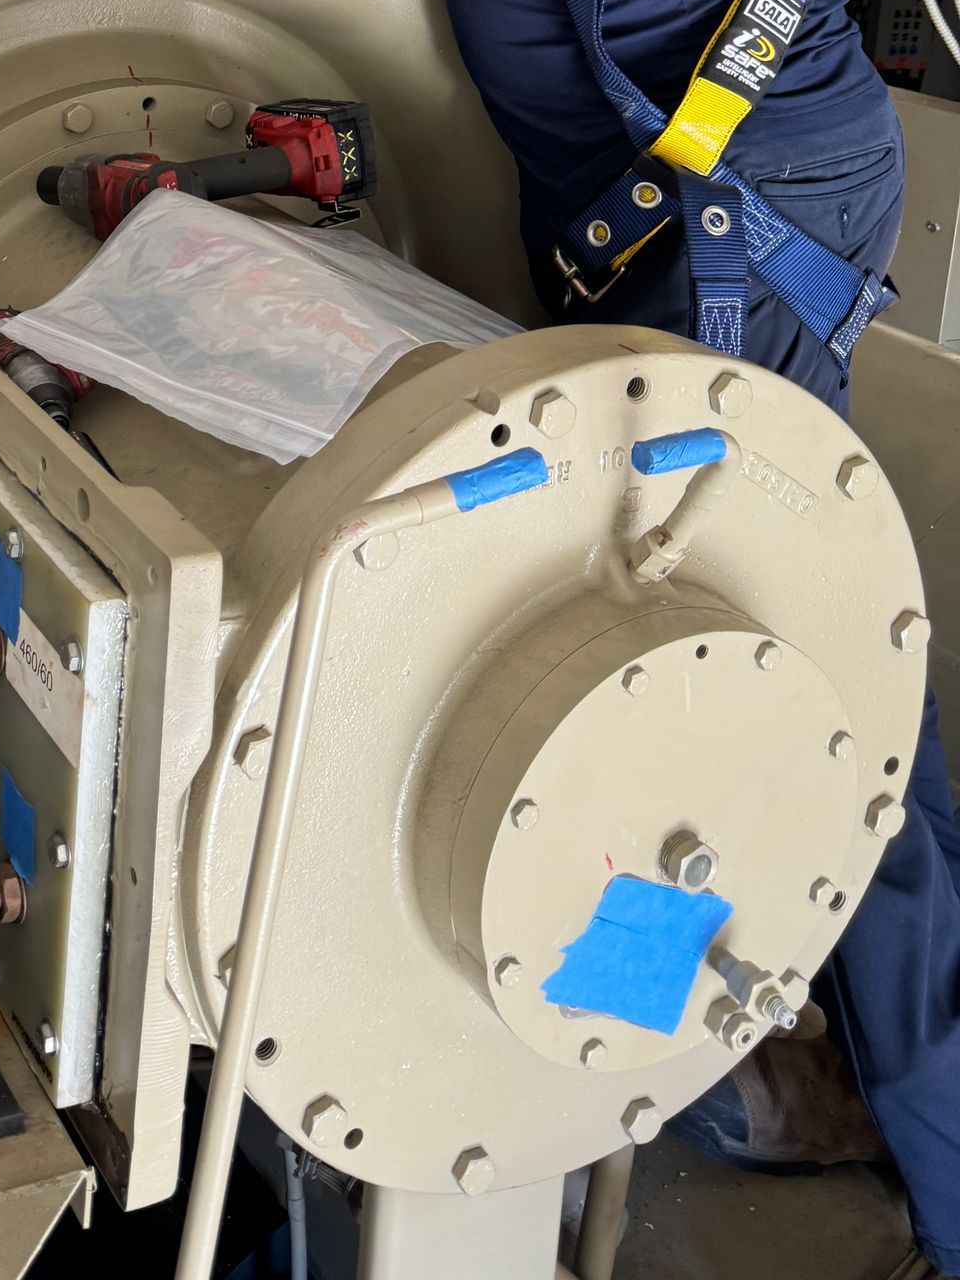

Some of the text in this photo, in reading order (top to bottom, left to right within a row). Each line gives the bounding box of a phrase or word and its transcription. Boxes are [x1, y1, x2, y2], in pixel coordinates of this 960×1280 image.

[757, 0, 791, 31] SALA
[715, 62, 761, 92] SAFETY SYSTEM
[722, 58, 760, 84] INTELLIGENT
[20, 639, 53, 692] 460/60
